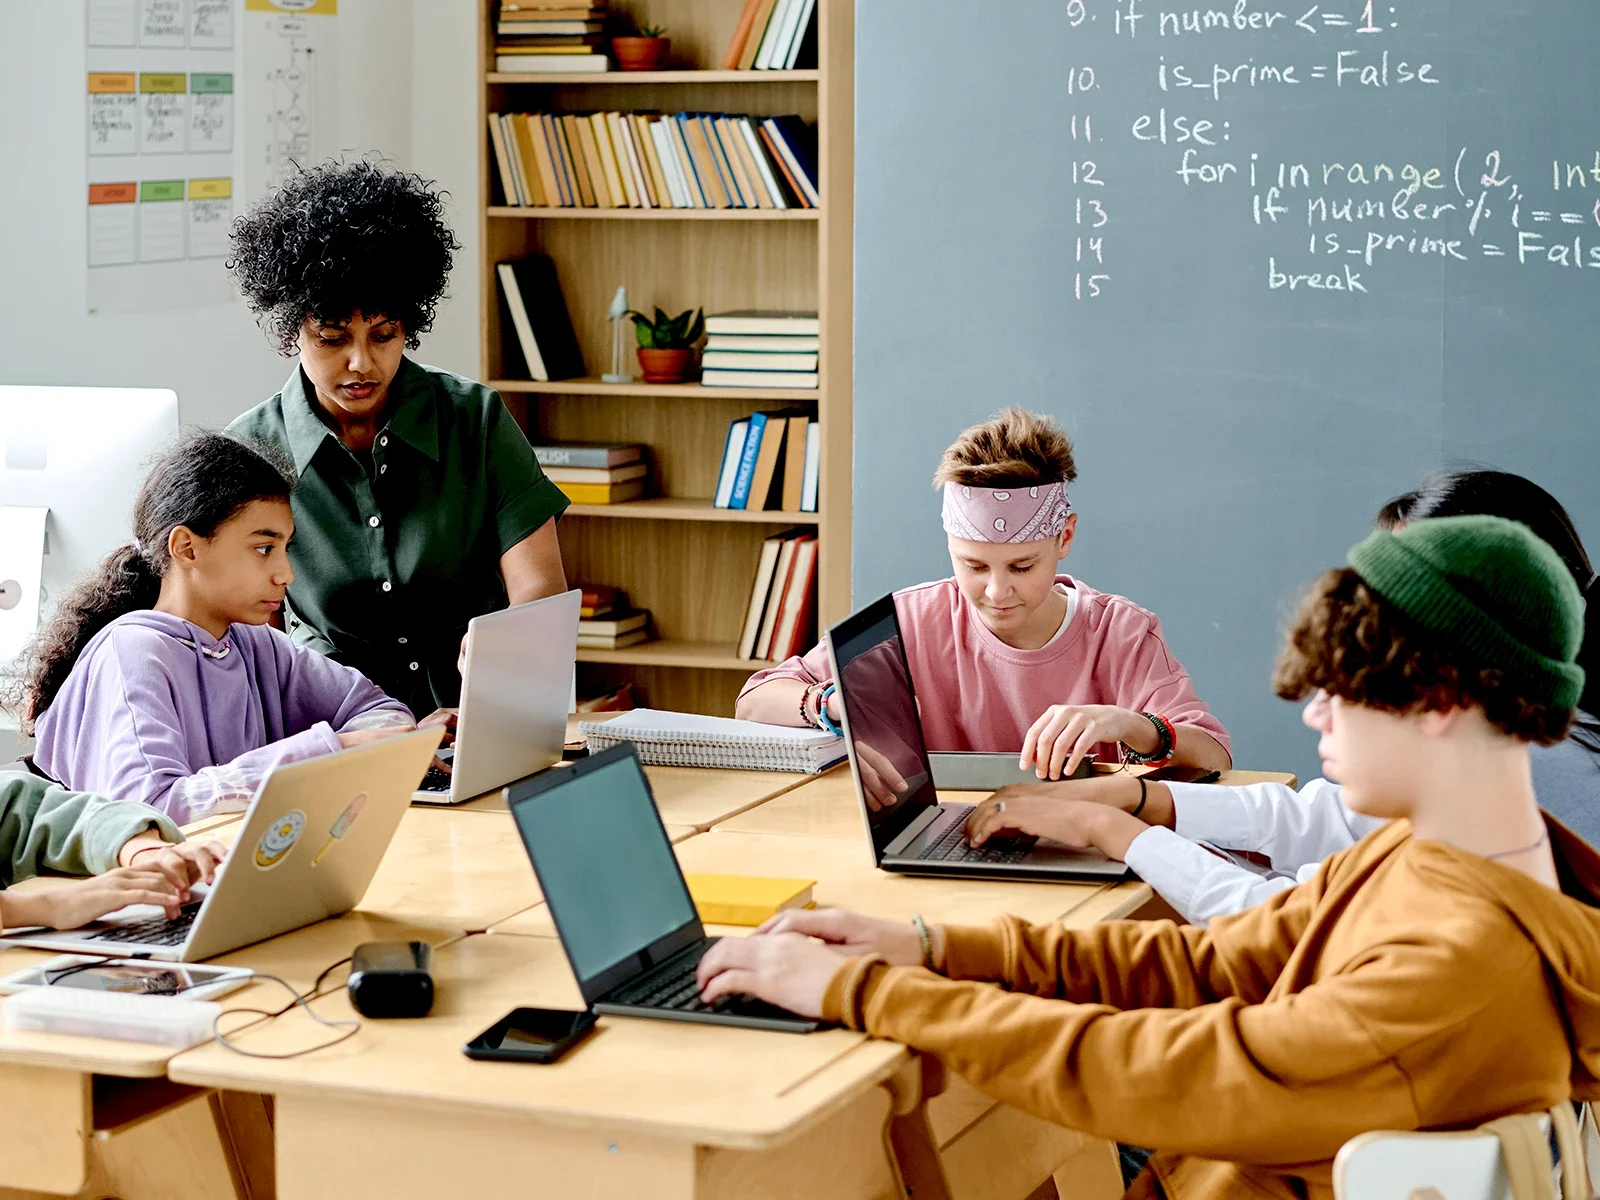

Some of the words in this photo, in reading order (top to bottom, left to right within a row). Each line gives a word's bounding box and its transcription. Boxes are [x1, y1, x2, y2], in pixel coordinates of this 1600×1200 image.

[1159, 0, 1287, 36] number
[1068, 67, 1101, 95] 10.
[1159, 55, 1301, 100] is_prime
[1336, 50, 1440, 87] False
[1132, 107, 1230, 146] else:
[1073, 160, 1105, 187] 12
[1176, 148, 1238, 187] for
[1076, 197, 1108, 228] 13
[1307, 188, 1457, 227] number
[1076, 237, 1103, 264] 14
[1310, 230, 1468, 266] is_prime
[1075, 272, 1112, 300] 15
[1268, 257, 1368, 293] break
[733, 461, 752, 500] SCIENCE
[743, 424, 760, 462] FICTION
